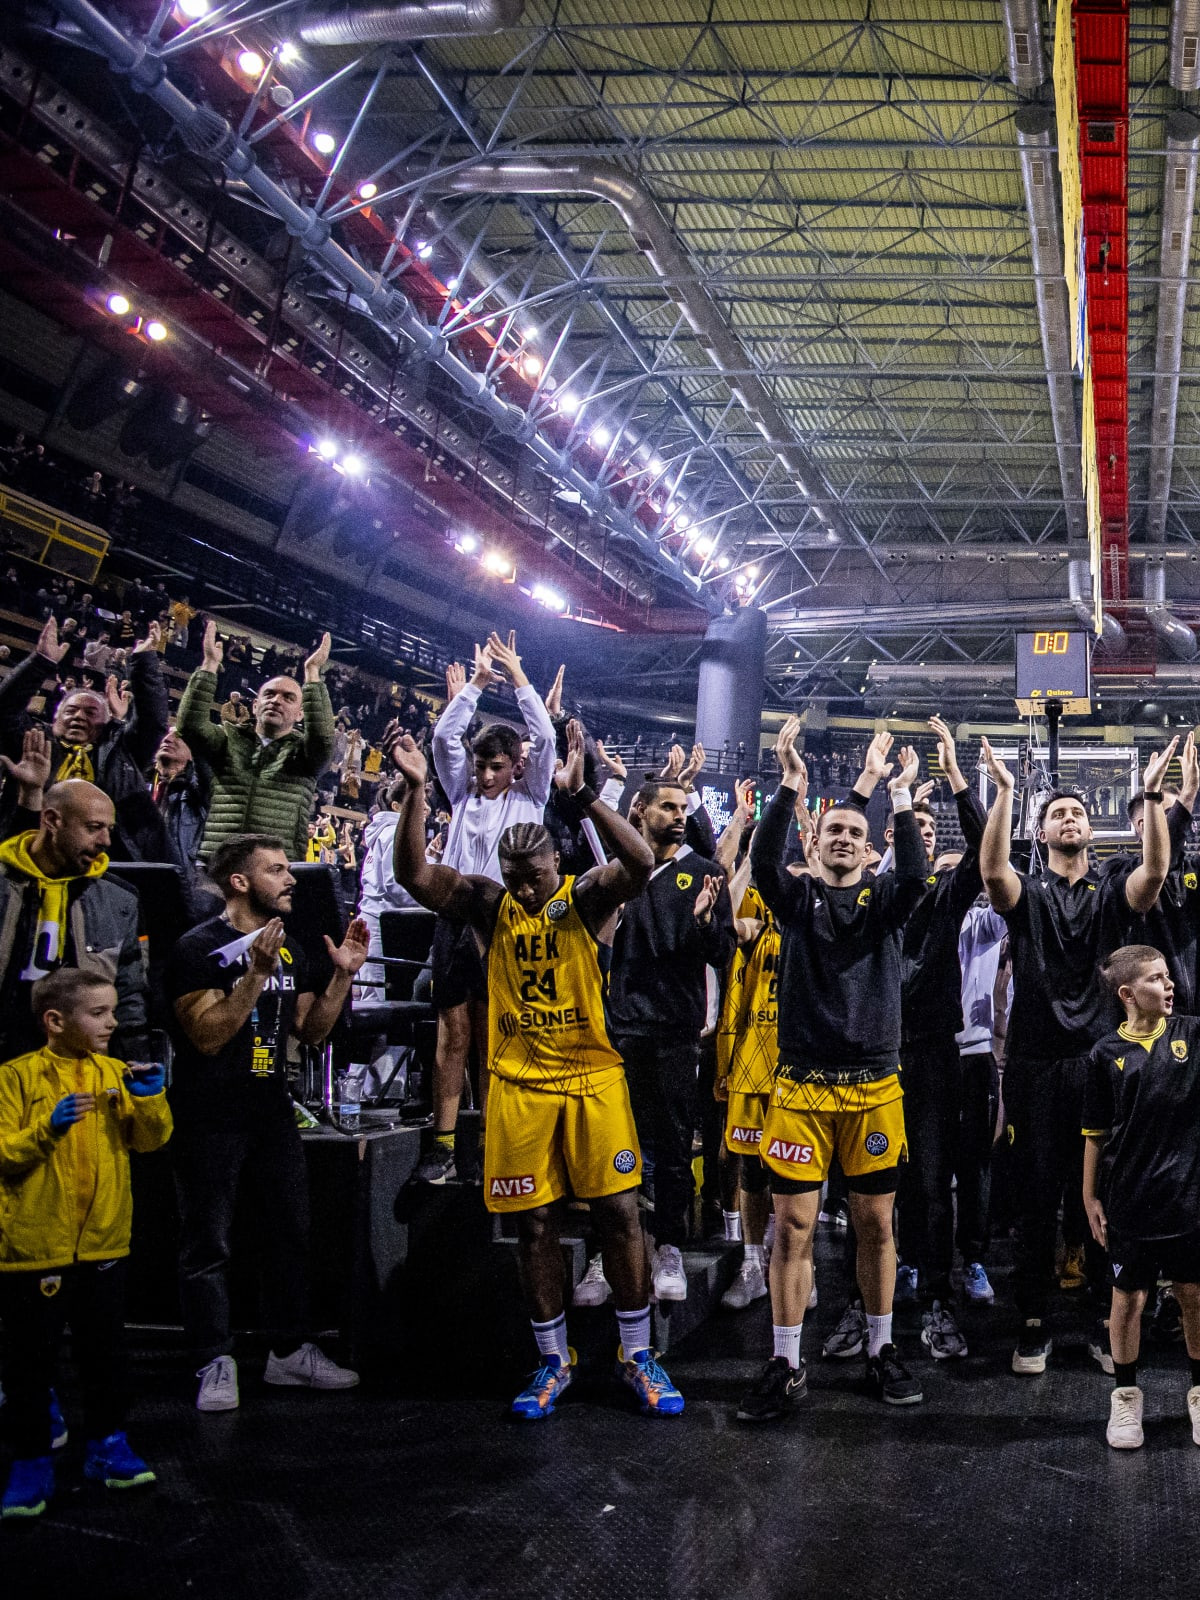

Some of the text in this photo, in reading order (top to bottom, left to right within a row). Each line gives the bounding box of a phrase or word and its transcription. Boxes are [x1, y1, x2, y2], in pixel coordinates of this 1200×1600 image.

[515, 930, 560, 962] AEK
[521, 968, 558, 1003] 24
[520, 1007, 590, 1029] SUNEL
[732, 1127, 763, 1142] AVIS
[768, 1140, 813, 1163] AVIS
[491, 1177, 535, 1196] AVIS
